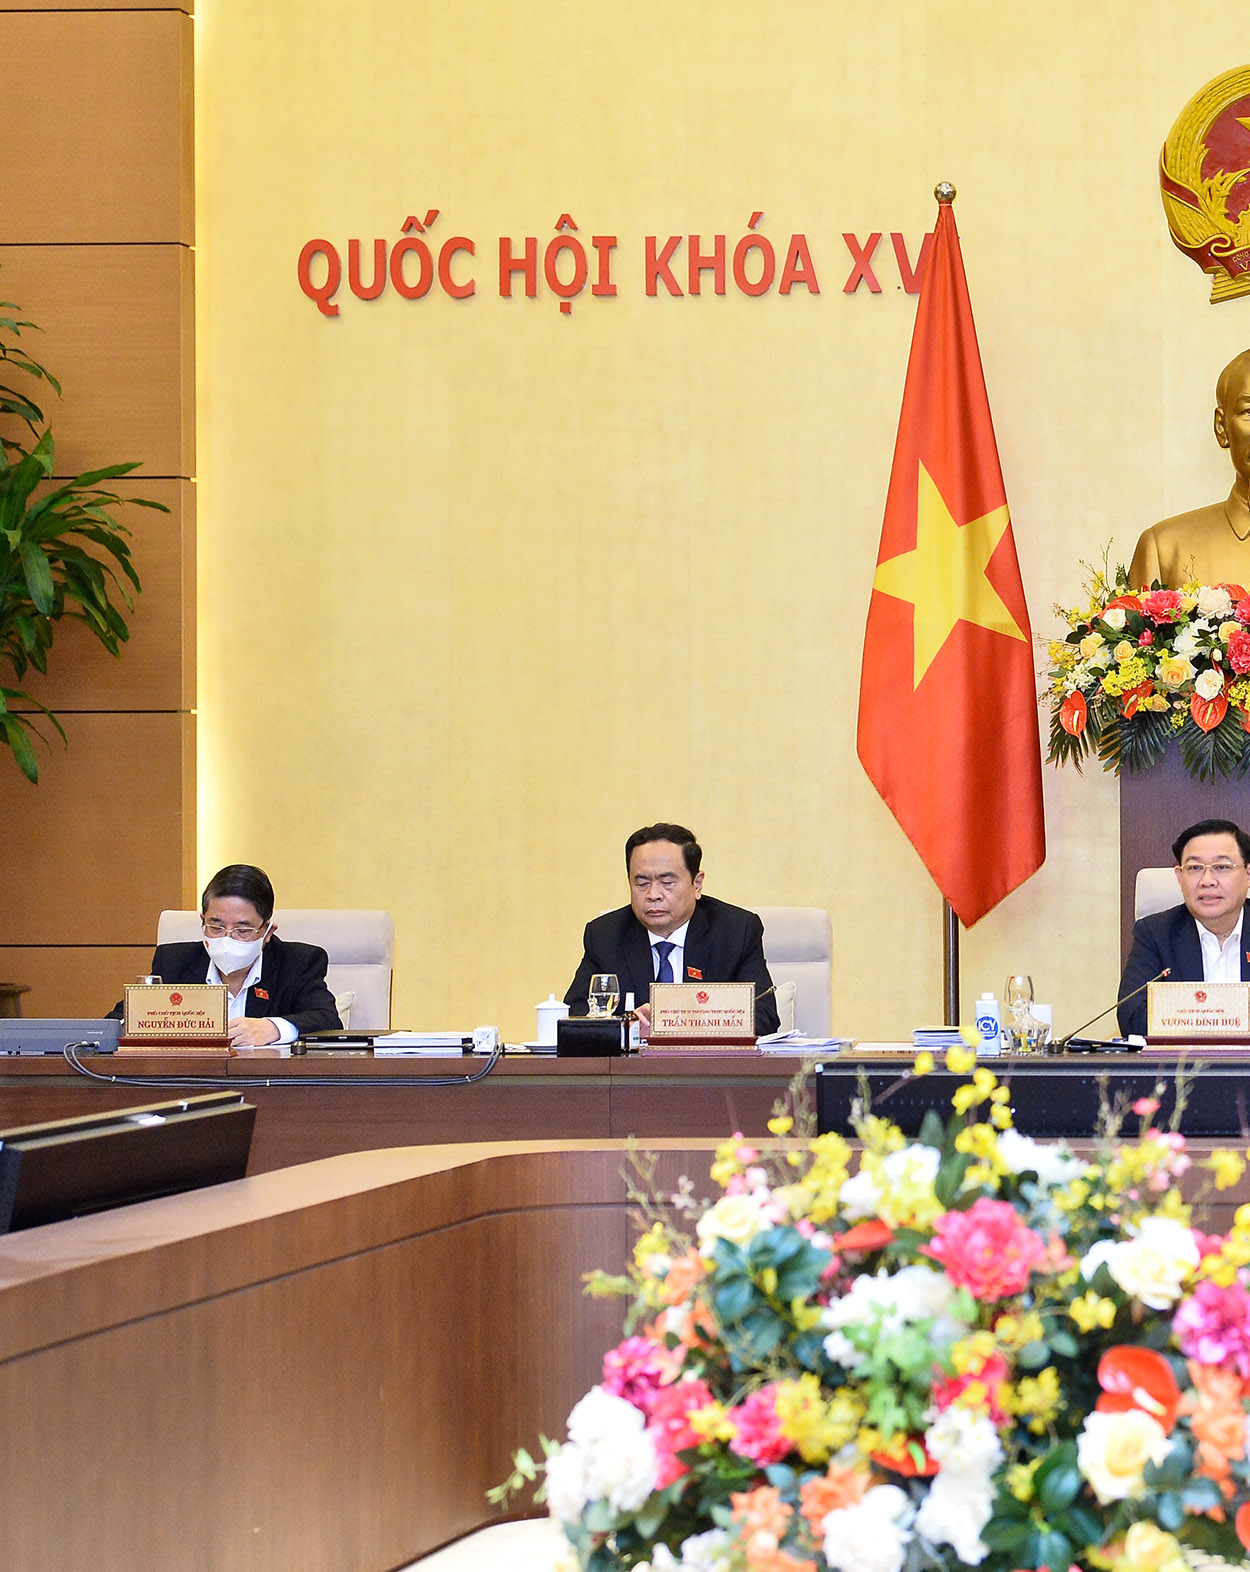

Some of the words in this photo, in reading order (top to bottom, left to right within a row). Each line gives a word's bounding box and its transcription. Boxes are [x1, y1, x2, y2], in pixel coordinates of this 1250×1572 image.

[298, 209, 475, 316] QUỐC
[499, 213, 618, 313] HỘI
[644, 211, 820, 297] KHÓA
[842, 232, 934, 294] XV
[138, 1017, 175, 1028] NGUYỄN
[177, 1018, 197, 1028] ĐỨC
[198, 1018, 215, 1028] HẢI
[689, 1019, 720, 1027] THANH
[978, 1020, 996, 1031] ICY
